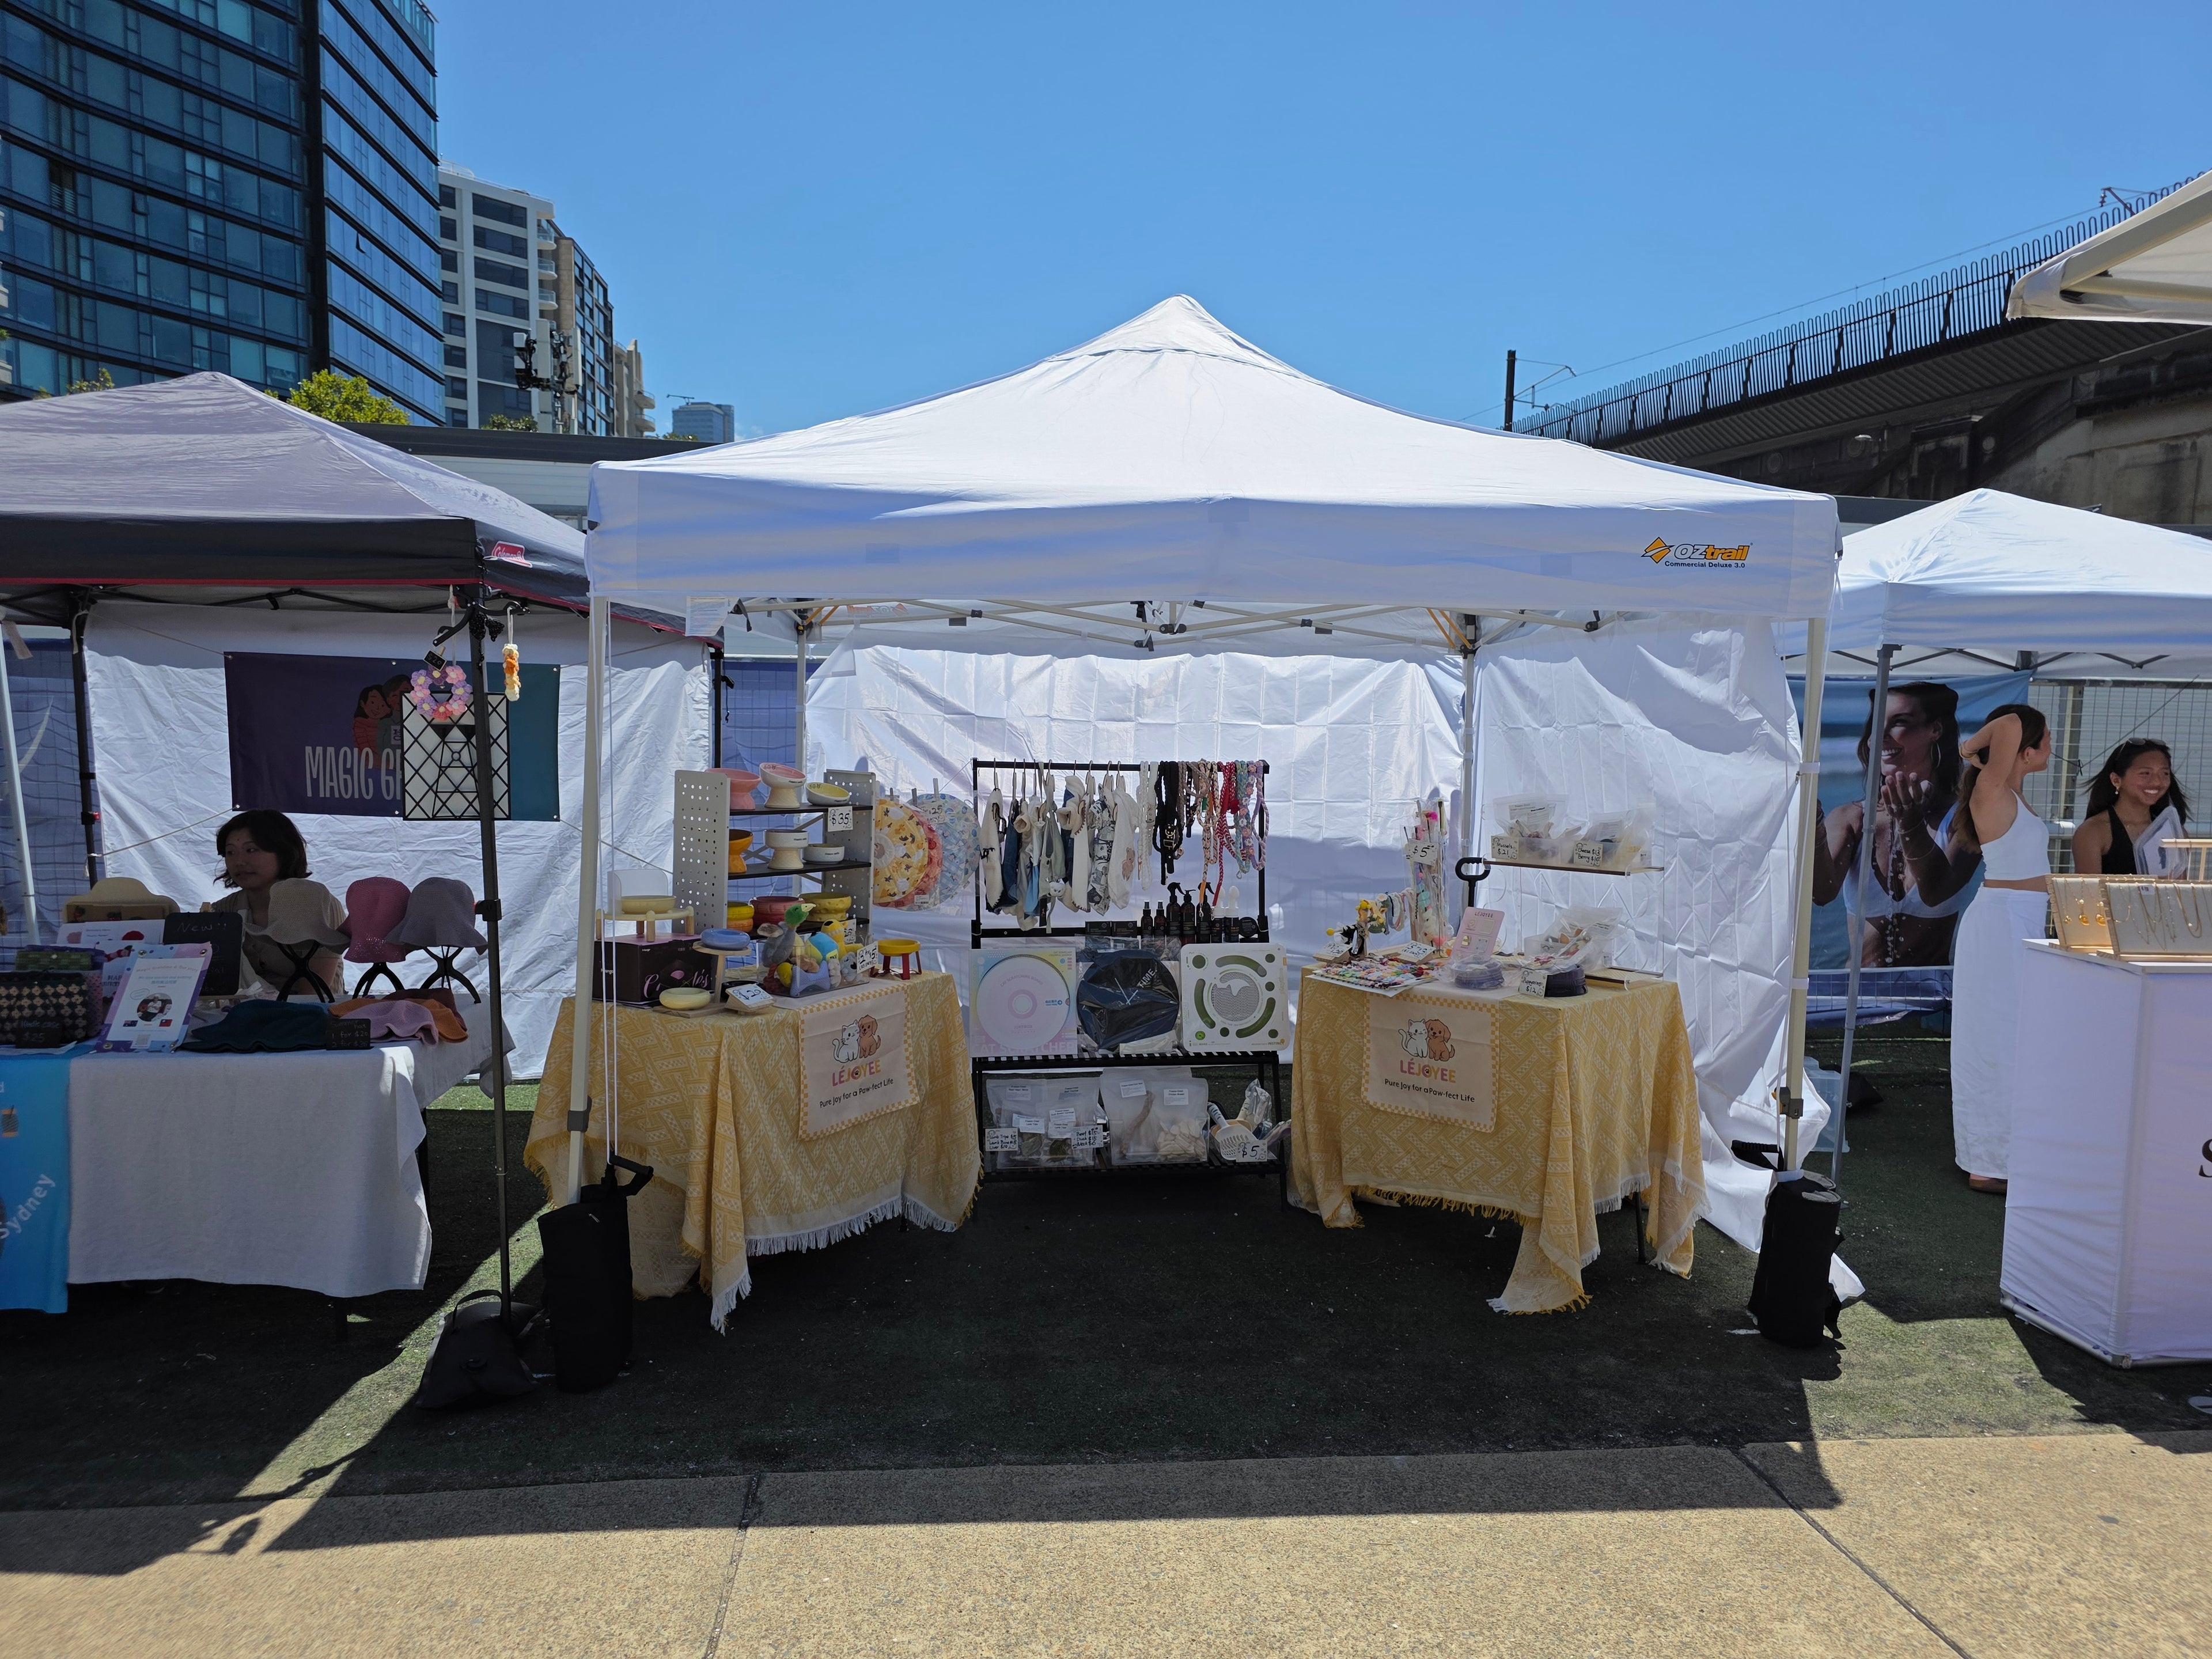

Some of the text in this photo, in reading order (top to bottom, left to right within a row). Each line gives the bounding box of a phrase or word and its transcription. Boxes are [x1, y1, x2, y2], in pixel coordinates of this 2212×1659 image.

[1674, 544, 1750, 560] OZtrail
[305, 746, 373, 800] MAGIC
[831, 812, 850, 827] $35
[1412, 845, 1430, 858] $5
[1578, 853, 1590, 863] Berry
[832, 1059, 882, 1087] LÉJOYEE
[1400, 1058, 1456, 1083] LÉJOYEE
[820, 1100, 832, 1109] Pure
[832, 1094, 842, 1106] Joy
[842, 1091, 852, 1100] for
[859, 1081, 882, 1095] Paw-fect
[883, 1078, 894, 1087] Life
[1384, 1078, 1400, 1088] Pure
[1400, 1082, 1411, 1092] Joy
[1412, 1084, 1422, 1093] for
[1429, 1088, 1459, 1100] Paw-fect
[1460, 1094, 1475, 1103] Life
[1242, 1145, 1260, 1158] $5
